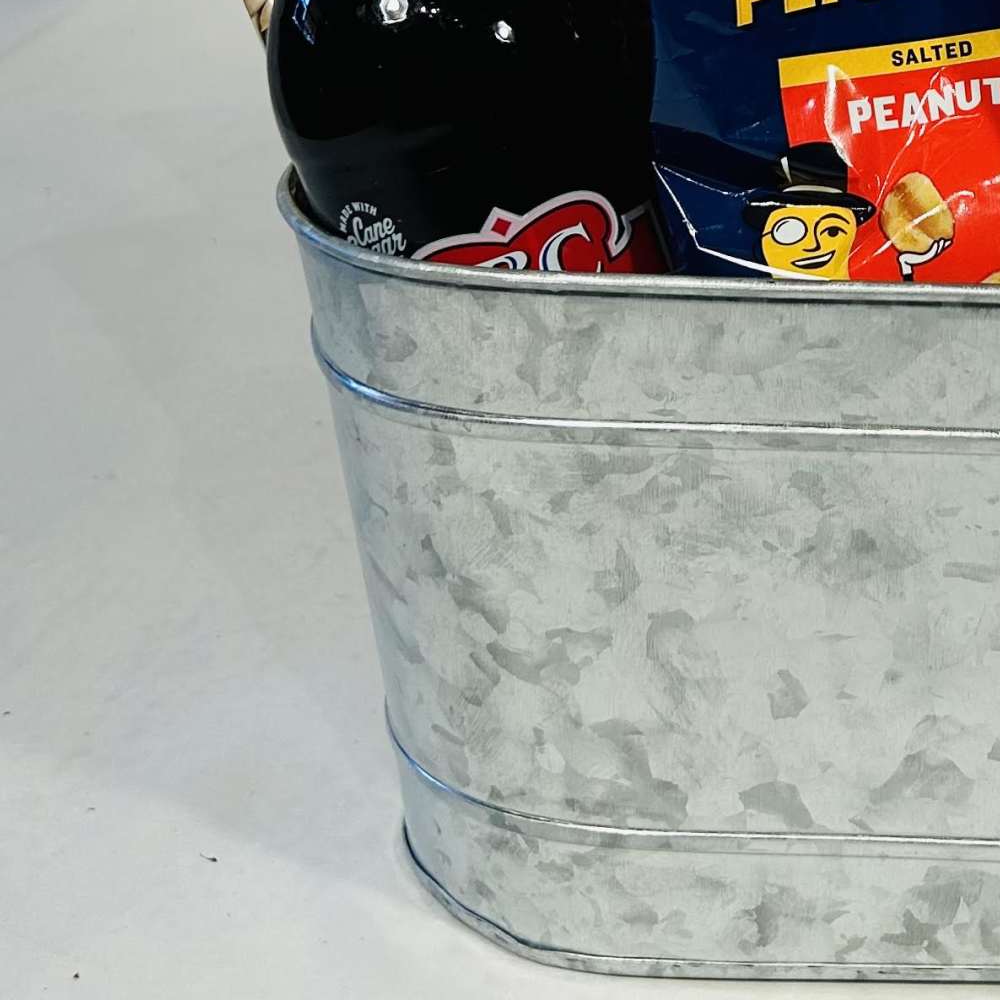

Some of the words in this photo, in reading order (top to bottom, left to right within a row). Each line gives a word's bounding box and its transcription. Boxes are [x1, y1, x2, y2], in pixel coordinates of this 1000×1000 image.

[891, 40, 973, 67] SALTED
[340, 204, 353, 233] MADE
[351, 202, 378, 216] WITH
[352, 216, 396, 247] Cane
